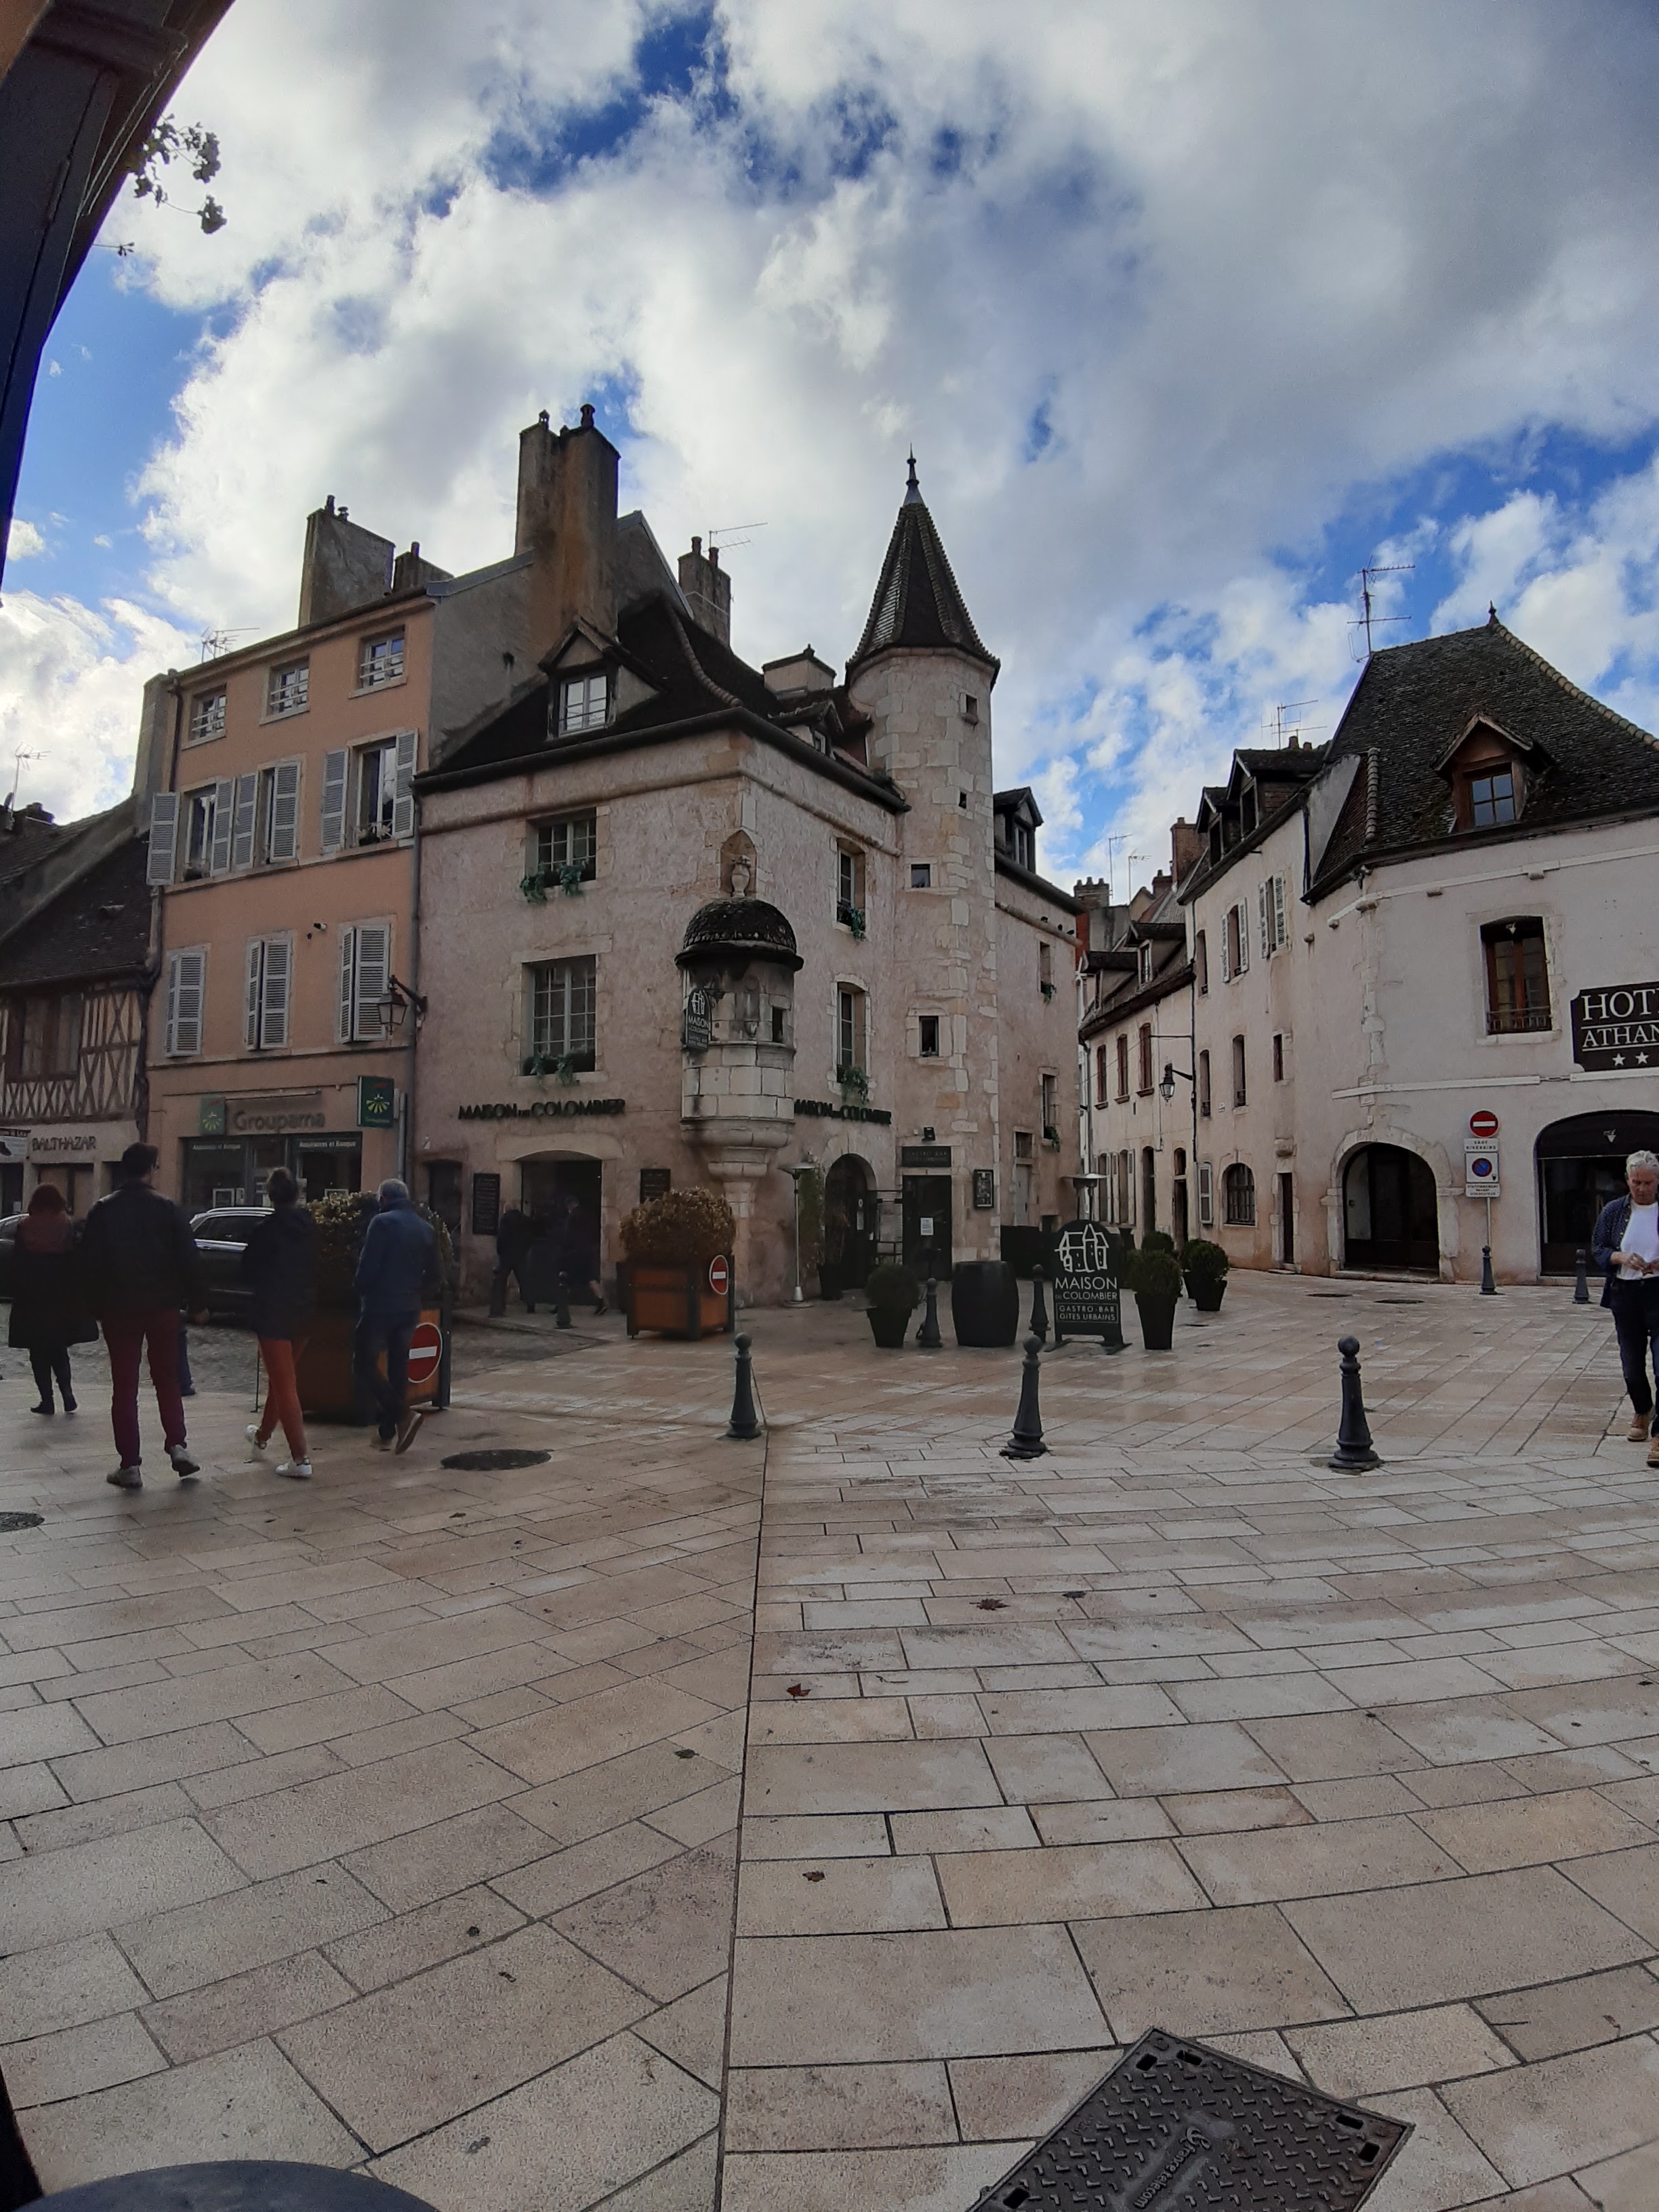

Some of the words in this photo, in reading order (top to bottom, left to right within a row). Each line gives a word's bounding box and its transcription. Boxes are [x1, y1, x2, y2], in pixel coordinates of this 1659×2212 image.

[1580, 988, 1659, 1021] HOT
[234, 1109, 325, 1134] Groupama
[32, 1136, 96, 1151] BALTHAZAR
[1055, 1276, 1118, 1290] MAISON
[1063, 1291, 1118, 1300] COLOMBIER
